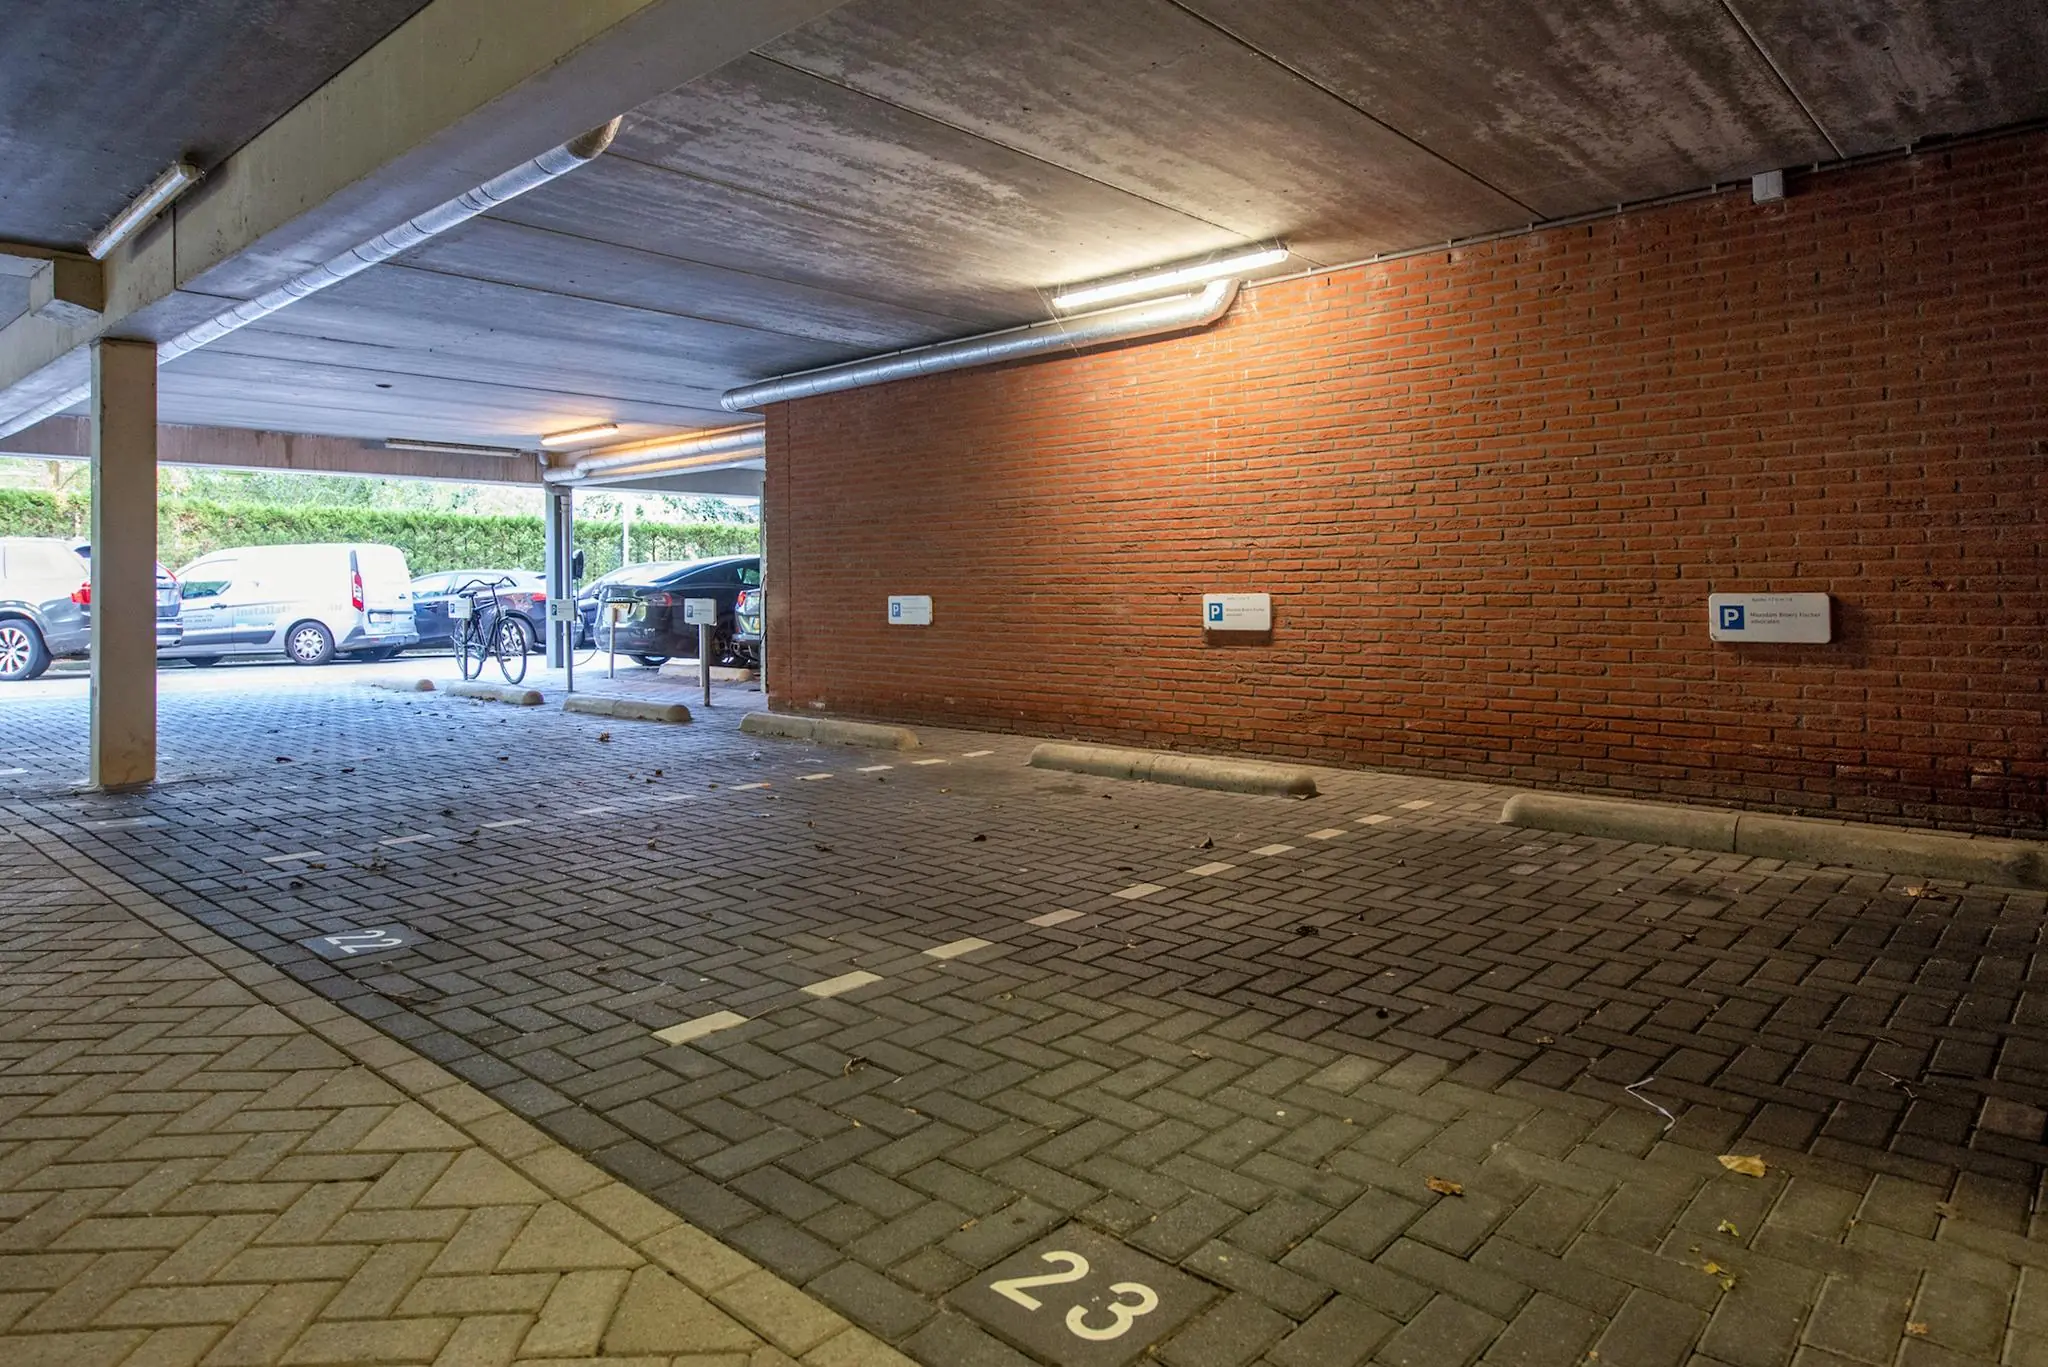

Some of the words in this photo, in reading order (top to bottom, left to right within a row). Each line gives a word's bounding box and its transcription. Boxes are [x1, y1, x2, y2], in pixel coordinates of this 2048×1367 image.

[1211, 605, 1220, 620] P
[1724, 608, 1739, 627] P
[324, 929, 403, 954] 22
[989, 1250, 1159, 1341] 23
